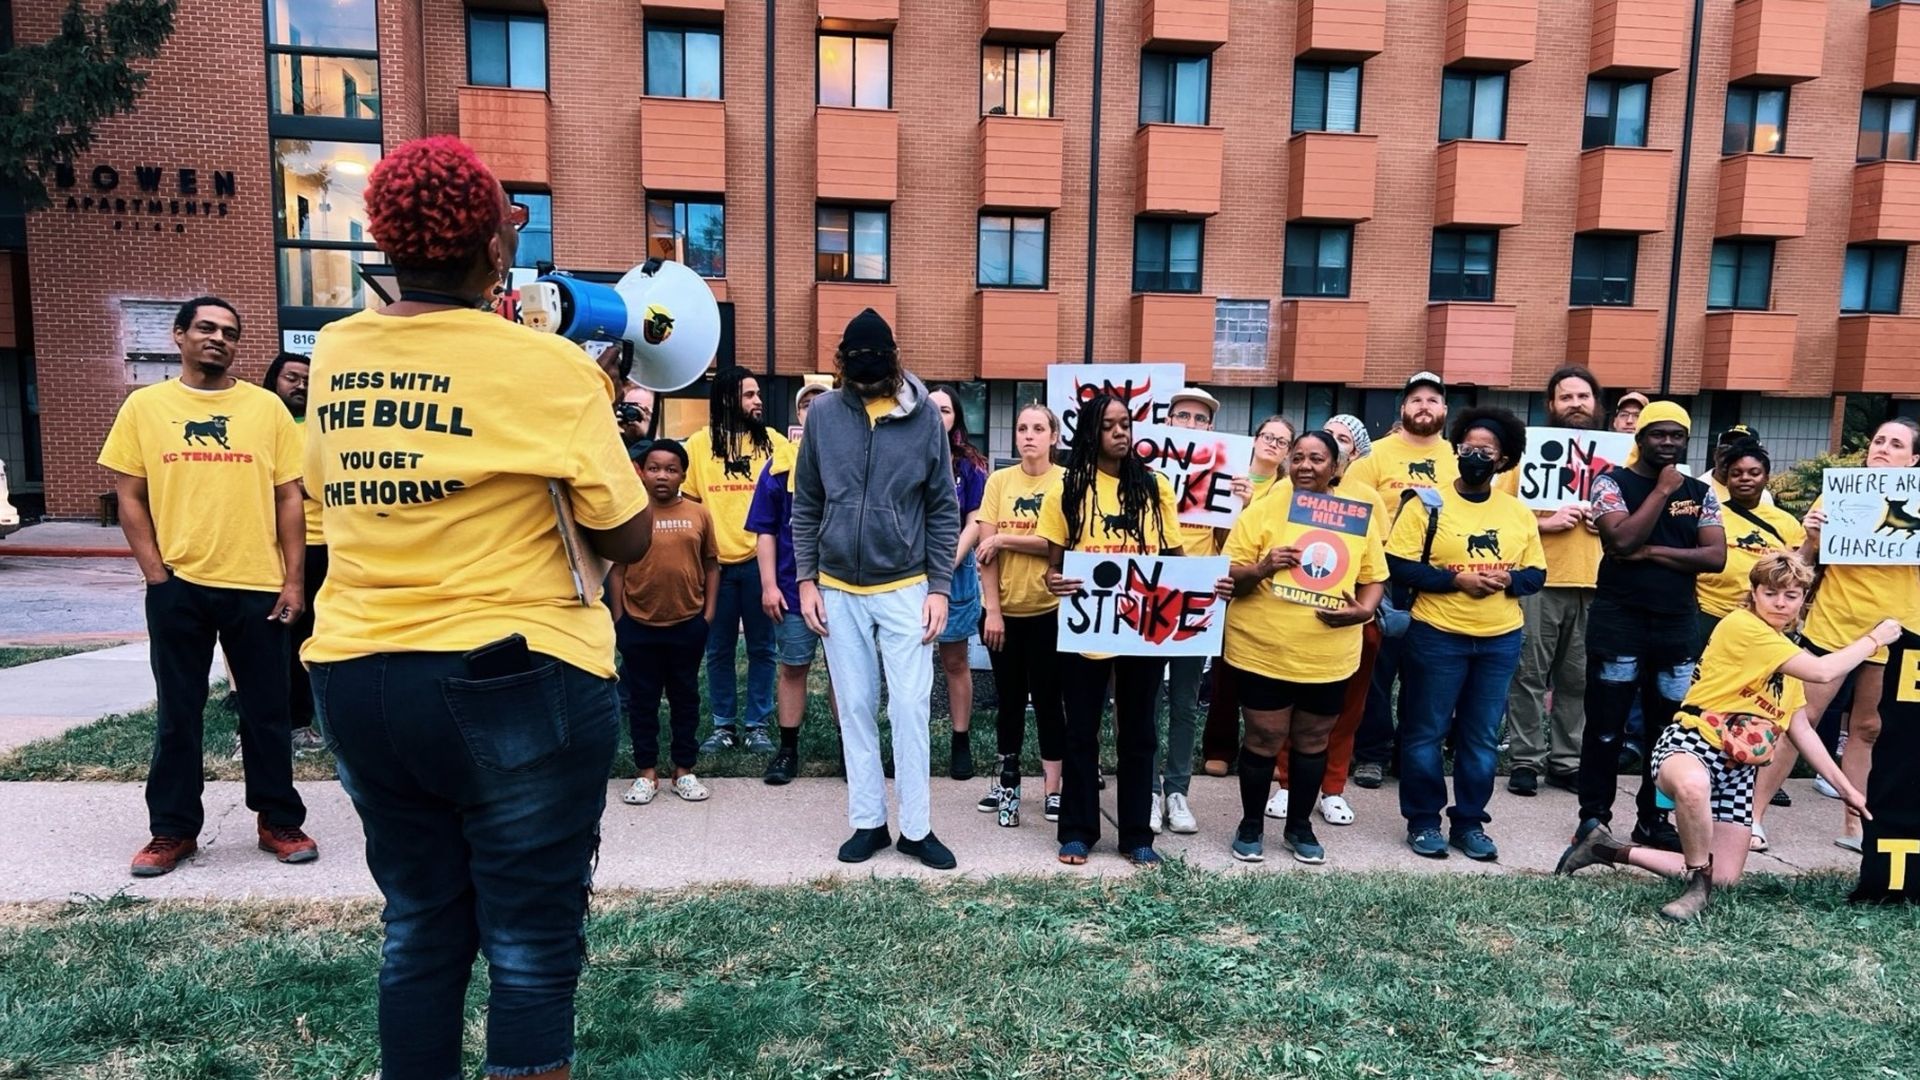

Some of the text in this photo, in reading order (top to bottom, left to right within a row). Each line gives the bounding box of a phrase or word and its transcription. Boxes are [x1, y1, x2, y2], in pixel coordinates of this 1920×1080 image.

[66, 196, 228, 217] APARTMENTS
[293, 334, 316, 344] 816
[331, 371, 451, 393] MESS WITH
[317, 399, 473, 437] THE BULL
[163, 452, 253, 464] KC TENANTS
[340, 451, 424, 470] YOU GET
[1133, 437, 1196, 470] ON
[1540, 437, 1597, 465] ON
[708, 483, 757, 493] KC TENAN
[1390, 481, 1404, 489] KC
[1521, 462, 1610, 501] STRIK
[1828, 473, 1920, 494] WHERE AR
[324, 479, 466, 508] THE HORNS
[1297, 495, 1367, 519] CHARLES
[1312, 509, 1346, 527] HILL
[1085, 545, 1100, 553] KC
[1828, 535, 1905, 558] CHARLES
[1093, 558, 1163, 592] ON
[1448, 564, 1465, 572] KC
[1274, 586, 1348, 609] SLUMLORD
[1067, 588, 1214, 637] STRIKE
